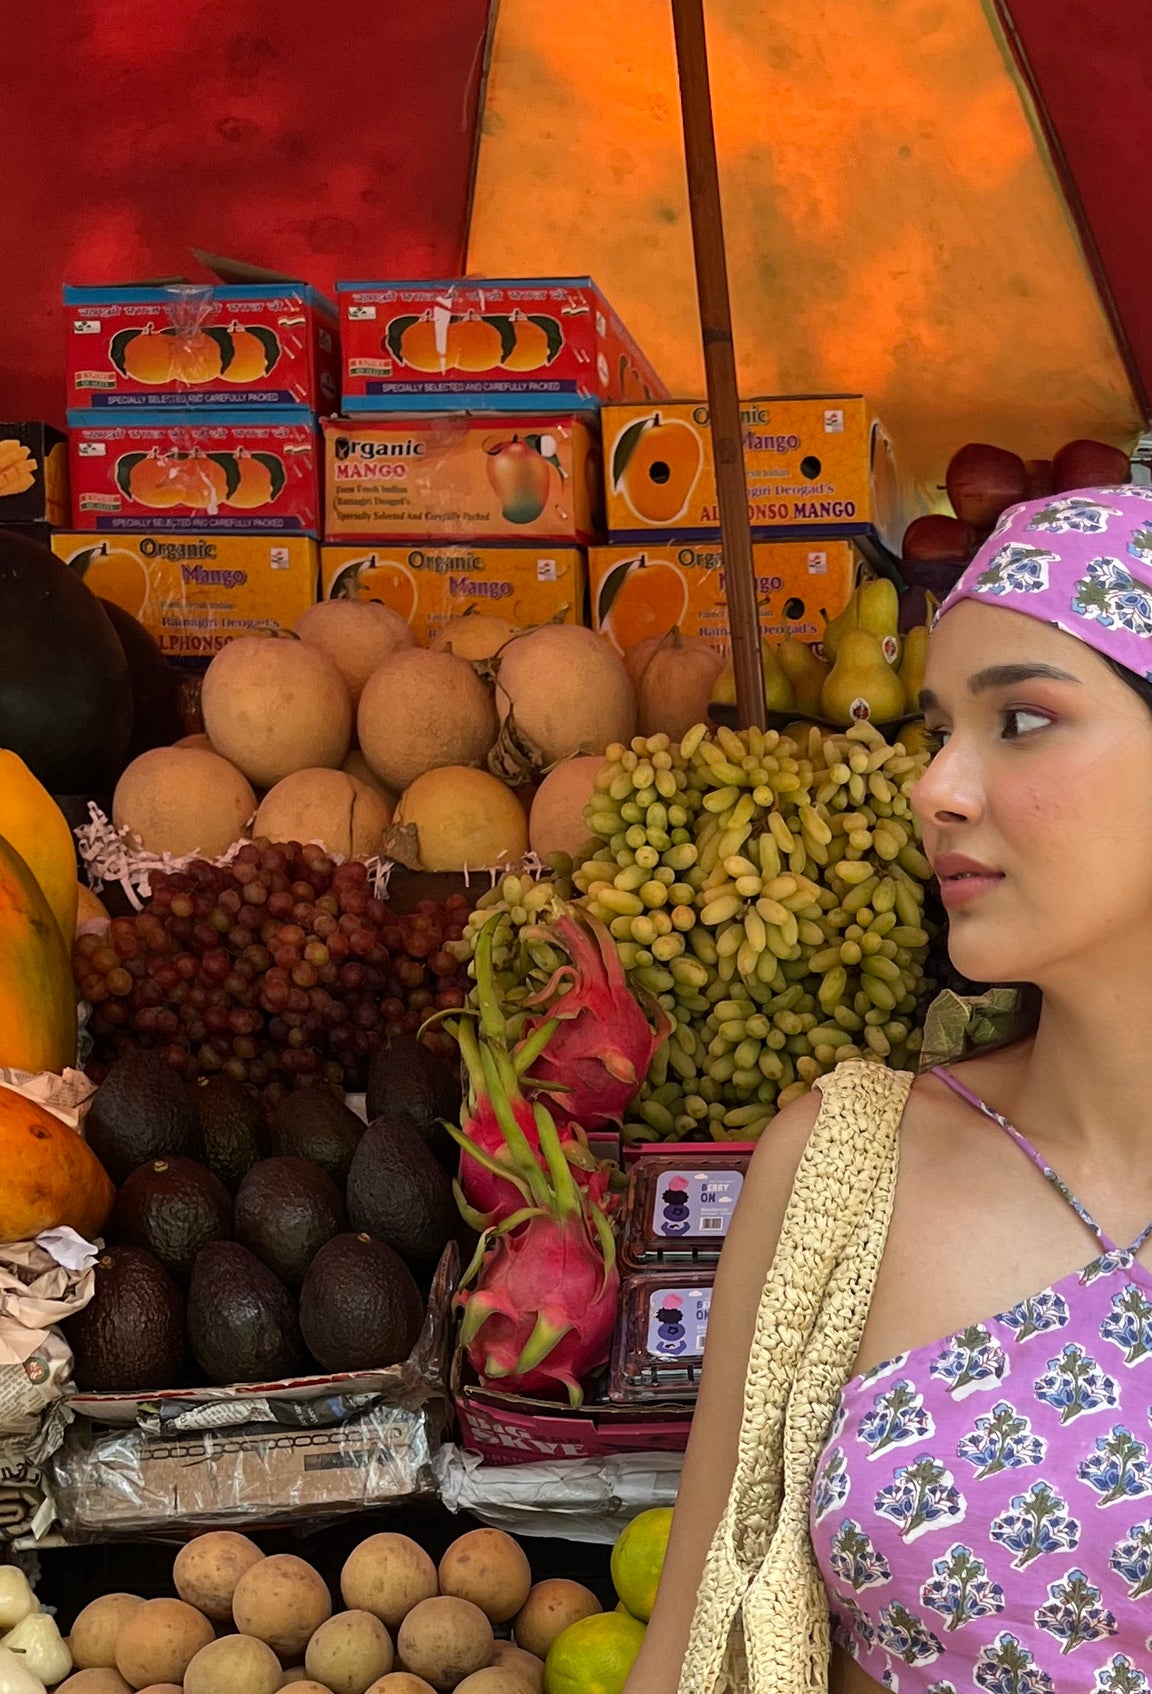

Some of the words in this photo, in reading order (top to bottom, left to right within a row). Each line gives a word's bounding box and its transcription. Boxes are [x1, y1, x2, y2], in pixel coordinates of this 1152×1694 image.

[693, 406, 770, 427] Onic
[335, 436, 424, 461] Organic
[336, 463, 406, 479] MANGO
[700, 504, 789, 522] ALONSO
[793, 501, 857, 519] MANGO
[139, 538, 218, 562] Organic
[408, 550, 482, 573] Organic
[180, 564, 248, 588] Mango
[449, 576, 514, 599] Mango
[158, 635, 234, 650] LPHONSO
[466, 1413, 533, 1439] BIG
